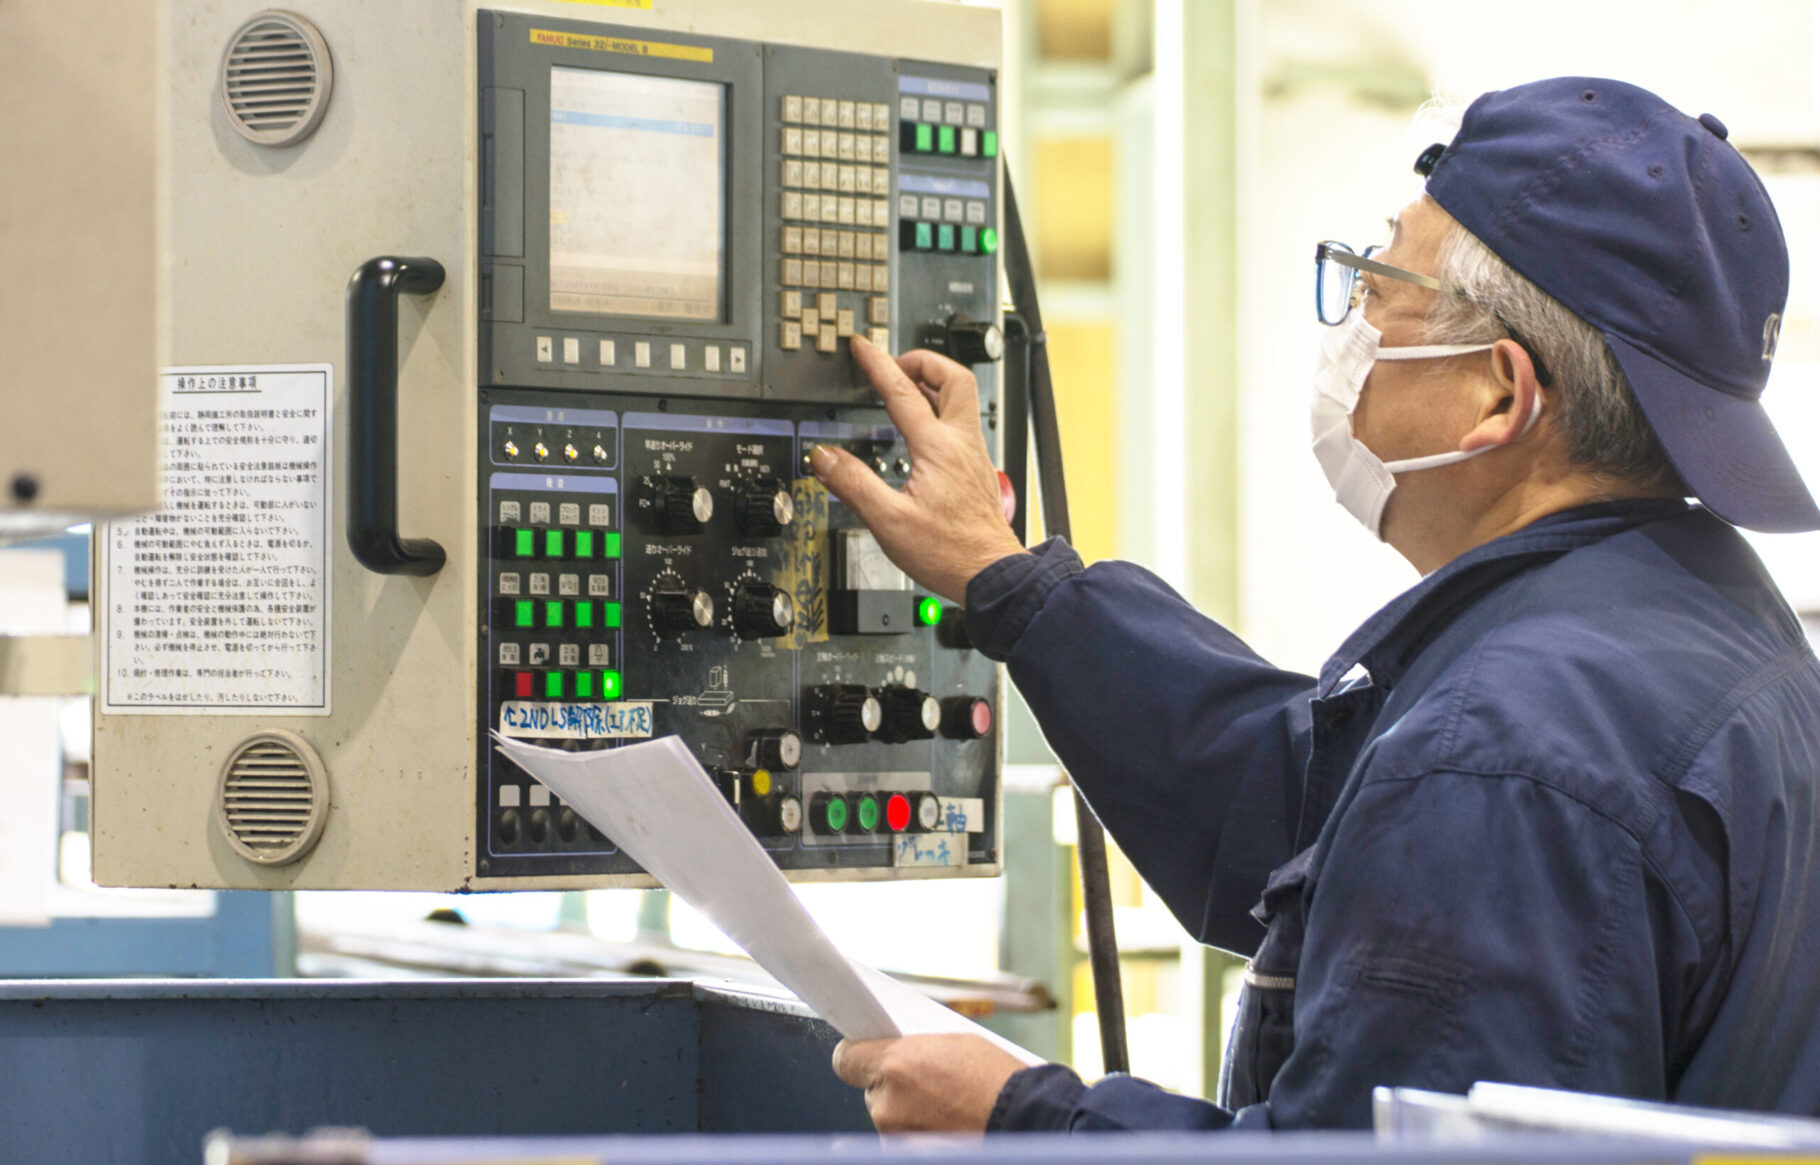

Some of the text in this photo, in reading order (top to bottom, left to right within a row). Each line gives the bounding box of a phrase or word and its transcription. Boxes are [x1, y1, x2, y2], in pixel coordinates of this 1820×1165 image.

[537, 33, 564, 45] FANUC
[566, 37, 591, 48] Series
[177, 376, 257, 390] 操作上の注意事項
[938, 802, 967, 836] 軸
